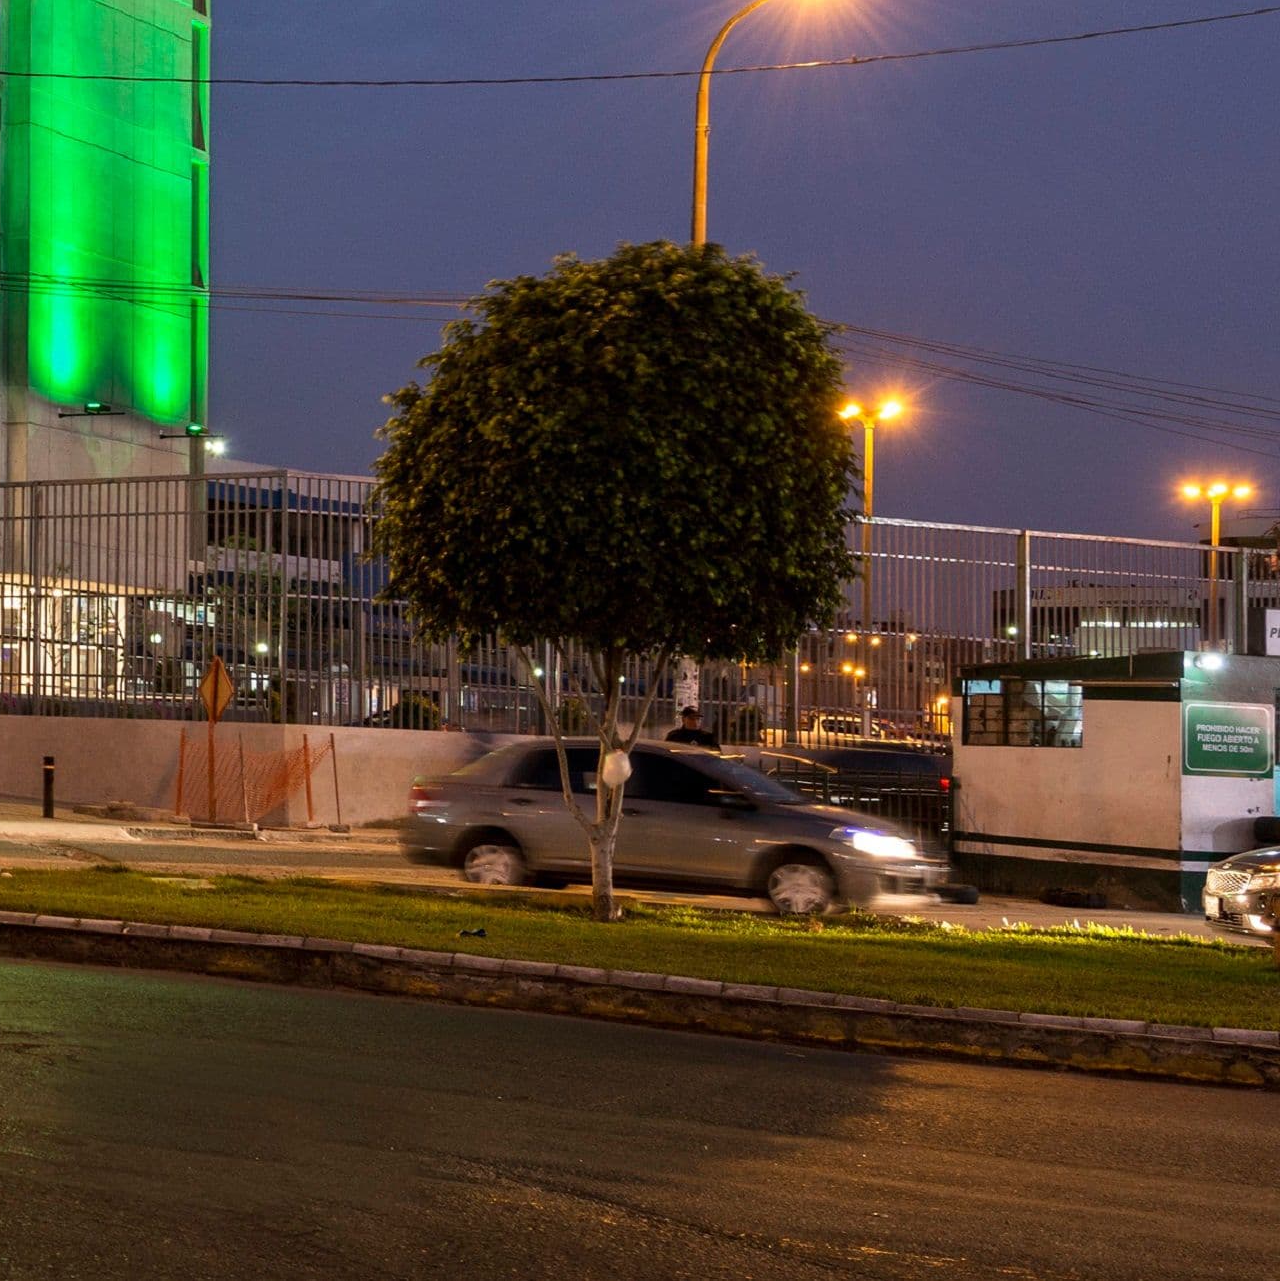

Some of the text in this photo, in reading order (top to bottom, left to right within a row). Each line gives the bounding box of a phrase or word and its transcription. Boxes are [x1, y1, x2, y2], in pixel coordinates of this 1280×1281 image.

[1196, 724, 1260, 734] PROHIBIDO HACER
[1197, 733, 1221, 742] FUEGO
[1222, 734, 1253, 744] ABIERTO
[1202, 743, 1228, 752] MENOS
[1228, 745, 1238, 753] DE
